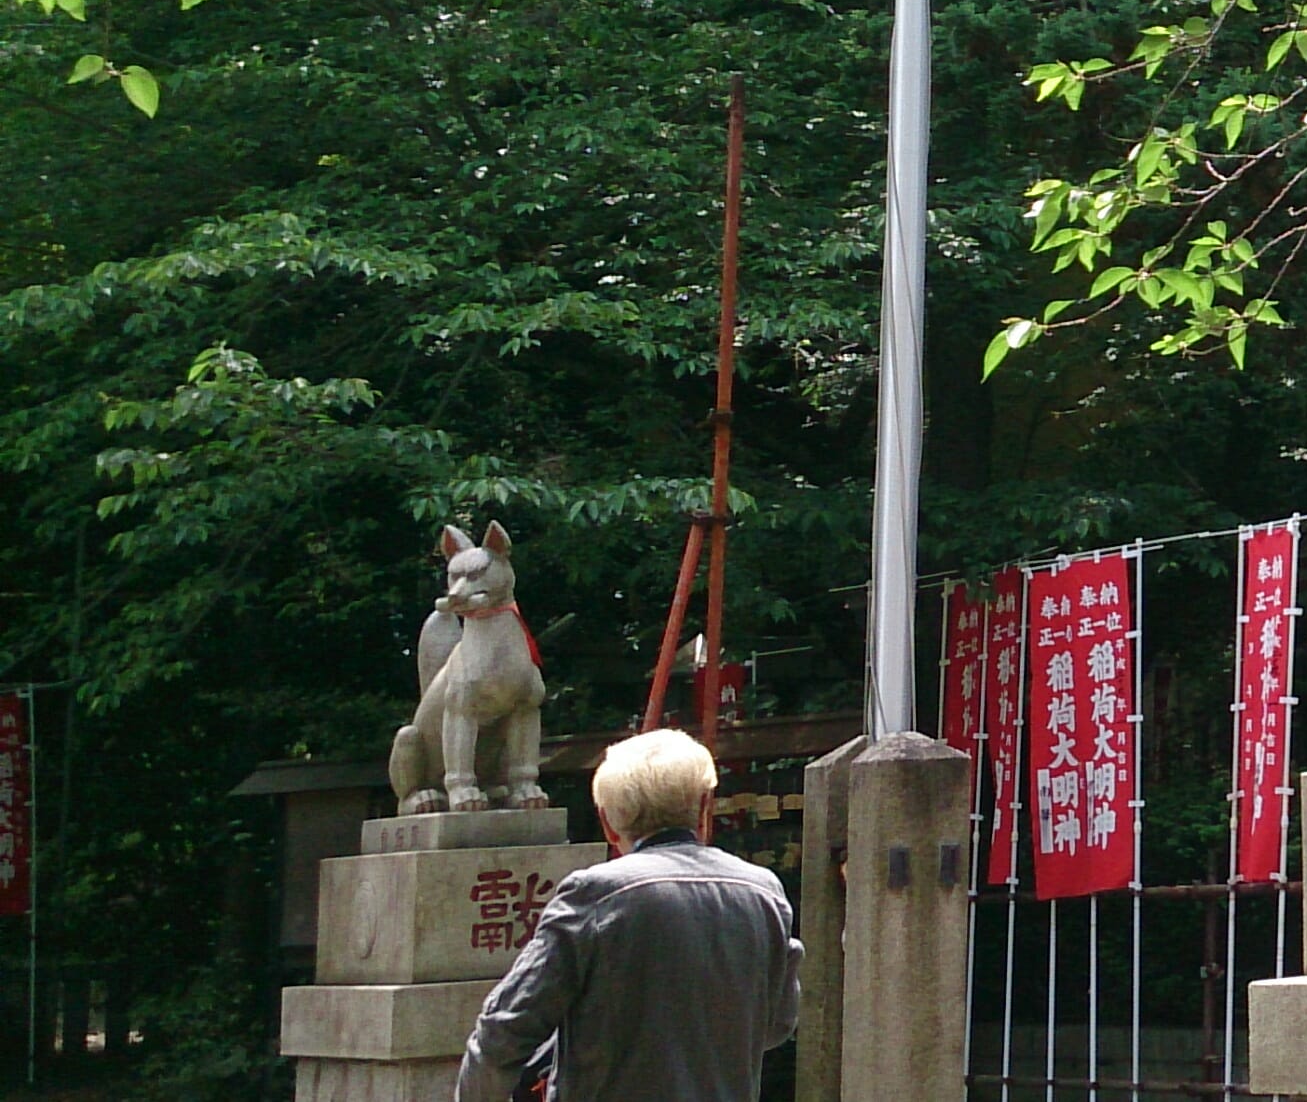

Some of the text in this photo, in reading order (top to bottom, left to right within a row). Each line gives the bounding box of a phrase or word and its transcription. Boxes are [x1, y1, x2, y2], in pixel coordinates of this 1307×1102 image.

[1078, 611, 1122, 637] 正一位
[1079, 581, 1119, 609] 奉納
[1047, 650, 1081, 855] 稲荷大明神
[1087, 640, 1117, 850] 稲荷大明神
